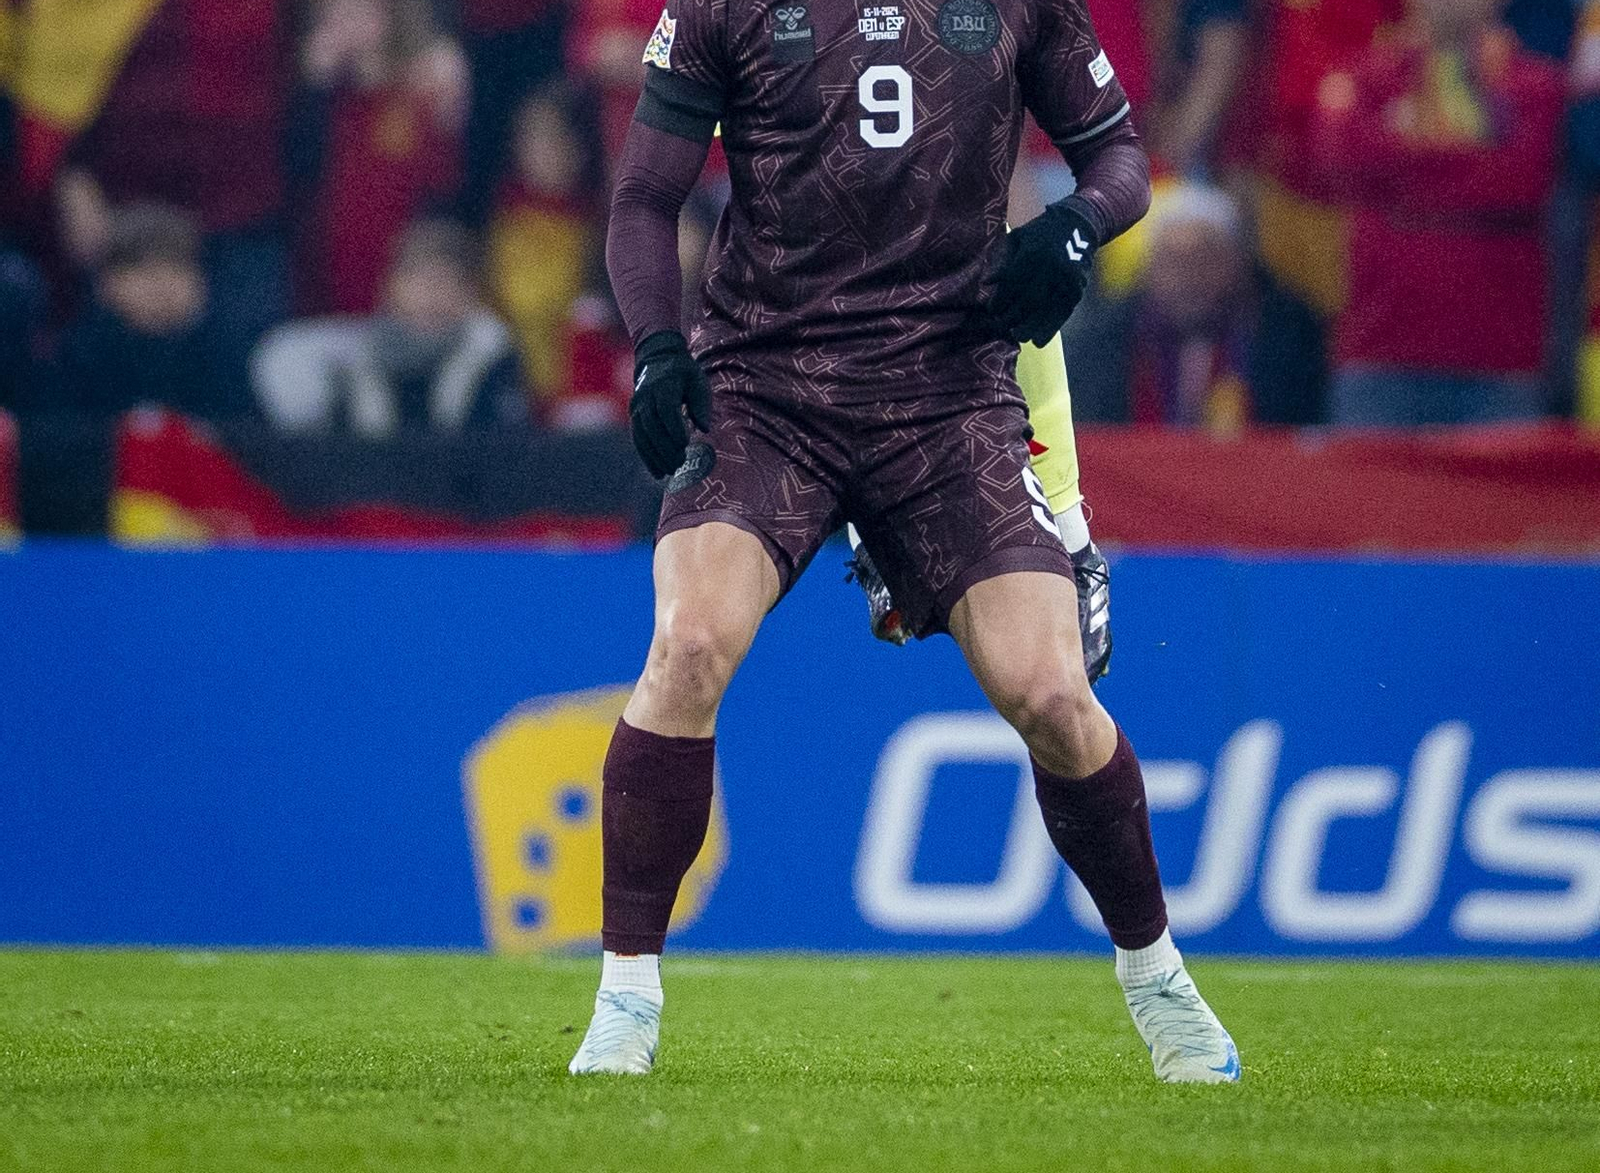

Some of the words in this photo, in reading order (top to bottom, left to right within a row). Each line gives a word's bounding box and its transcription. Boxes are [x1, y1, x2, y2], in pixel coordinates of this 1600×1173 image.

[863, 5, 899, 17] 15-11-2024
[886, 16, 905, 31] ESP
[952, 15, 986, 32] DBU
[858, 65, 913, 148] 9
[853, 711, 1600, 941] Odds
